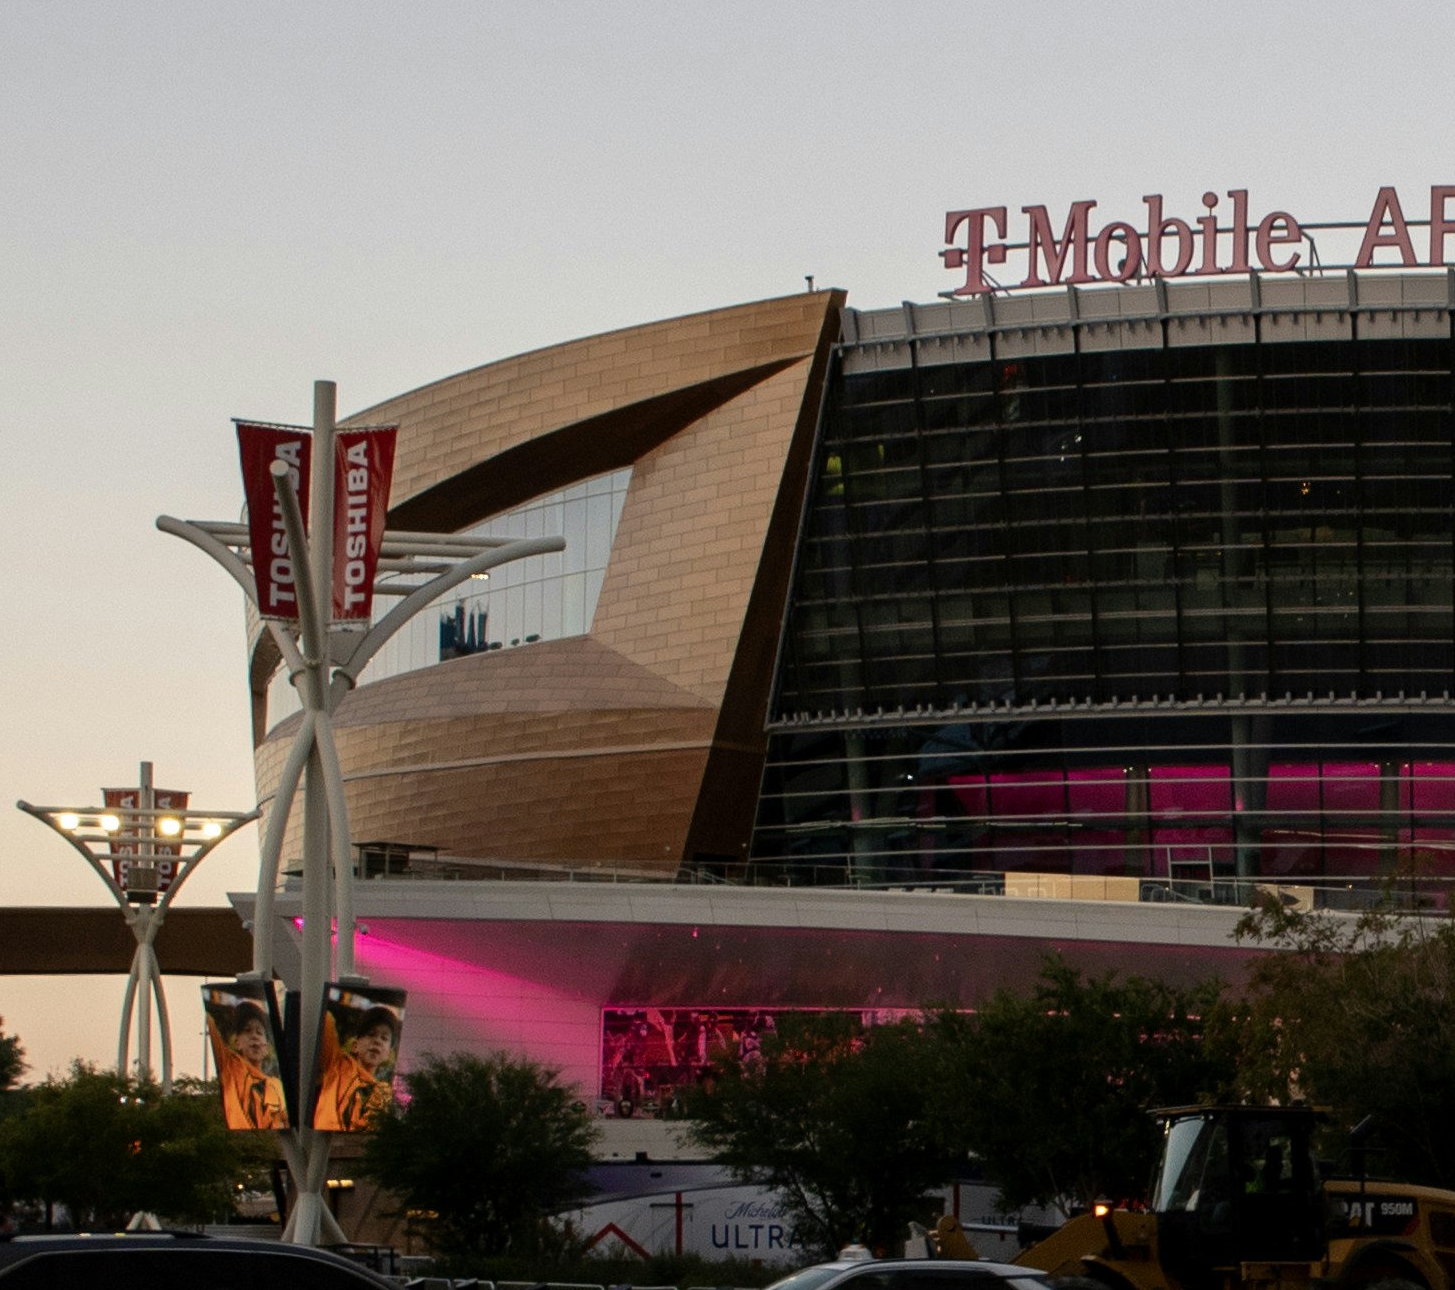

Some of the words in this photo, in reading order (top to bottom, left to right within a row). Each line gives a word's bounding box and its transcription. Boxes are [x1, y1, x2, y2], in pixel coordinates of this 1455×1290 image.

[345, 440, 369, 611] TOSHIBA
[1380, 1201, 1414, 1216] 950M
[712, 1224, 805, 1249] ULTRA
